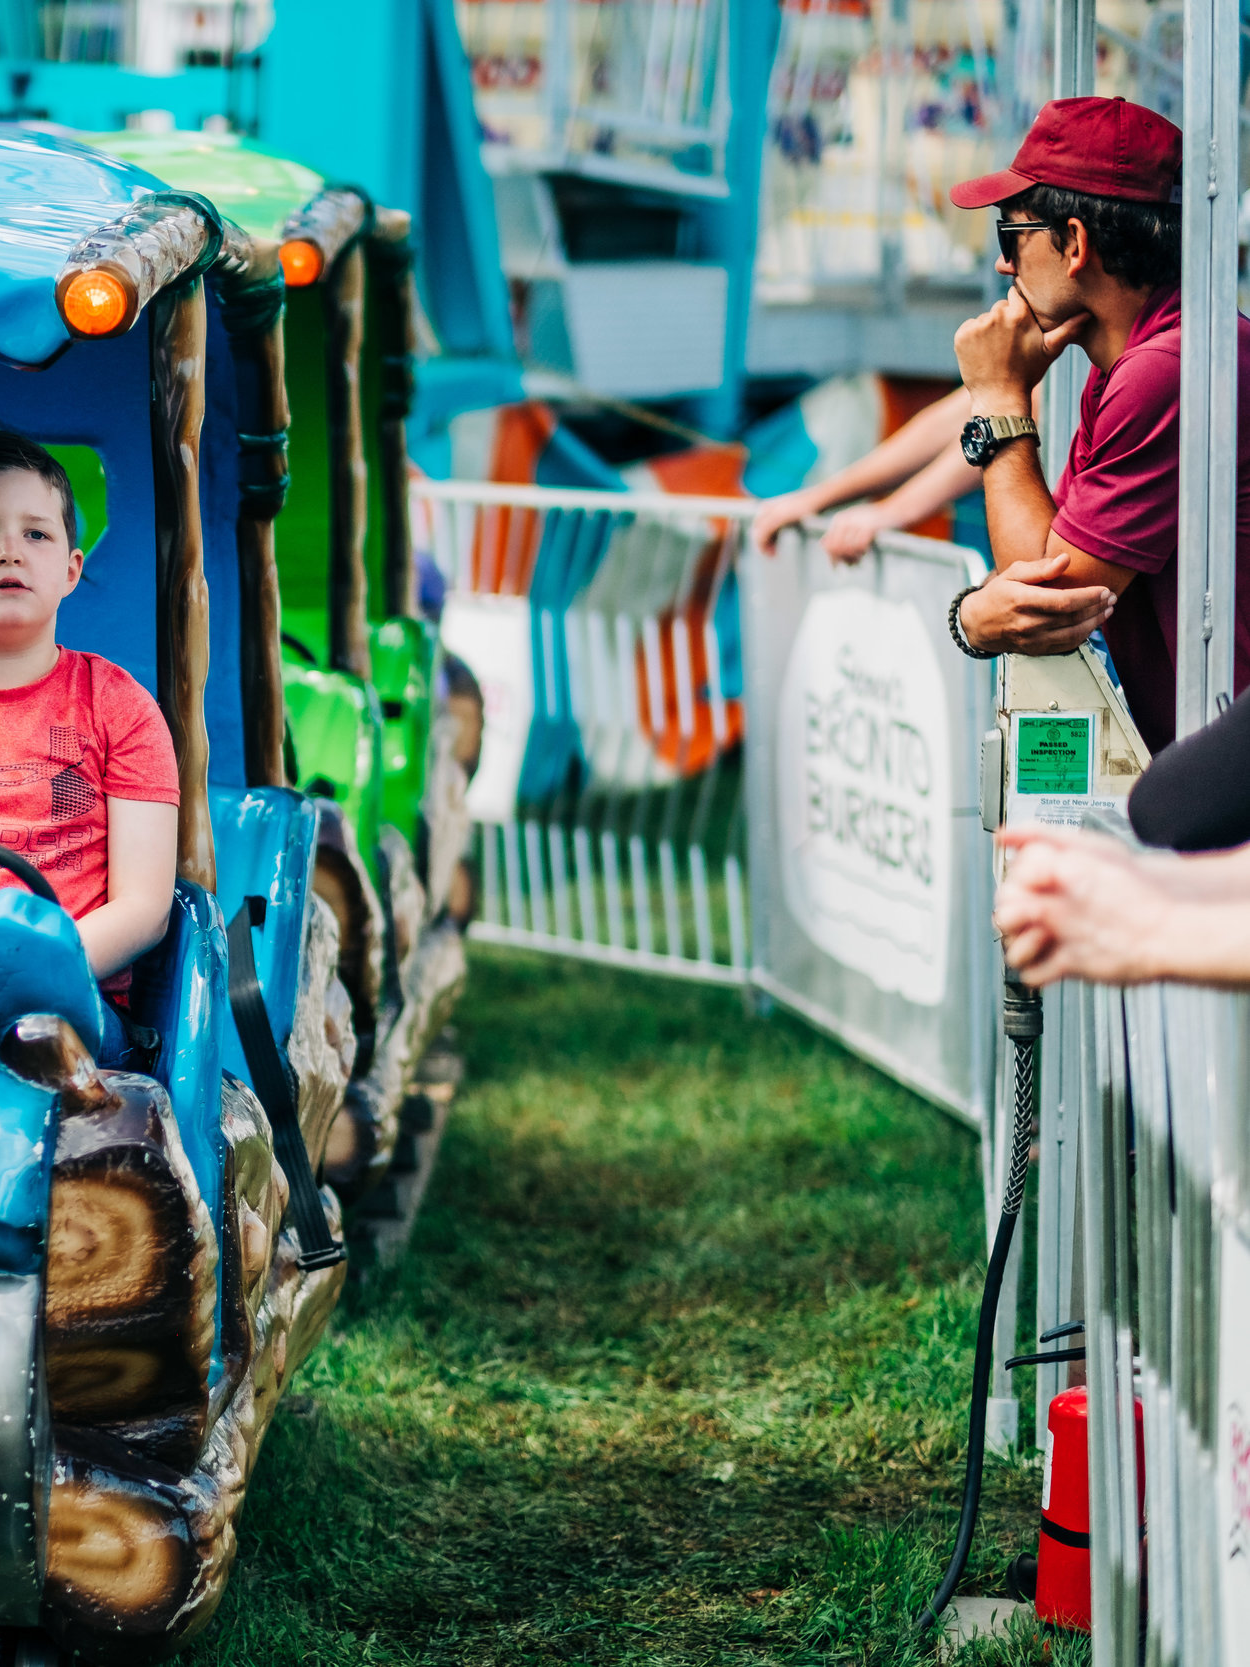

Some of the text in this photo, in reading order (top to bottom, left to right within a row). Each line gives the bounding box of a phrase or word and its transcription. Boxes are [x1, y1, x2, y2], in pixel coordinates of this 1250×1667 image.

[805, 690, 932, 798] BRONTO
[805, 769, 933, 887] BURGERS
[1040, 798, 1061, 806] State
[1072, 799, 1088, 807] New
[1090, 800, 1116, 809] Jersey
